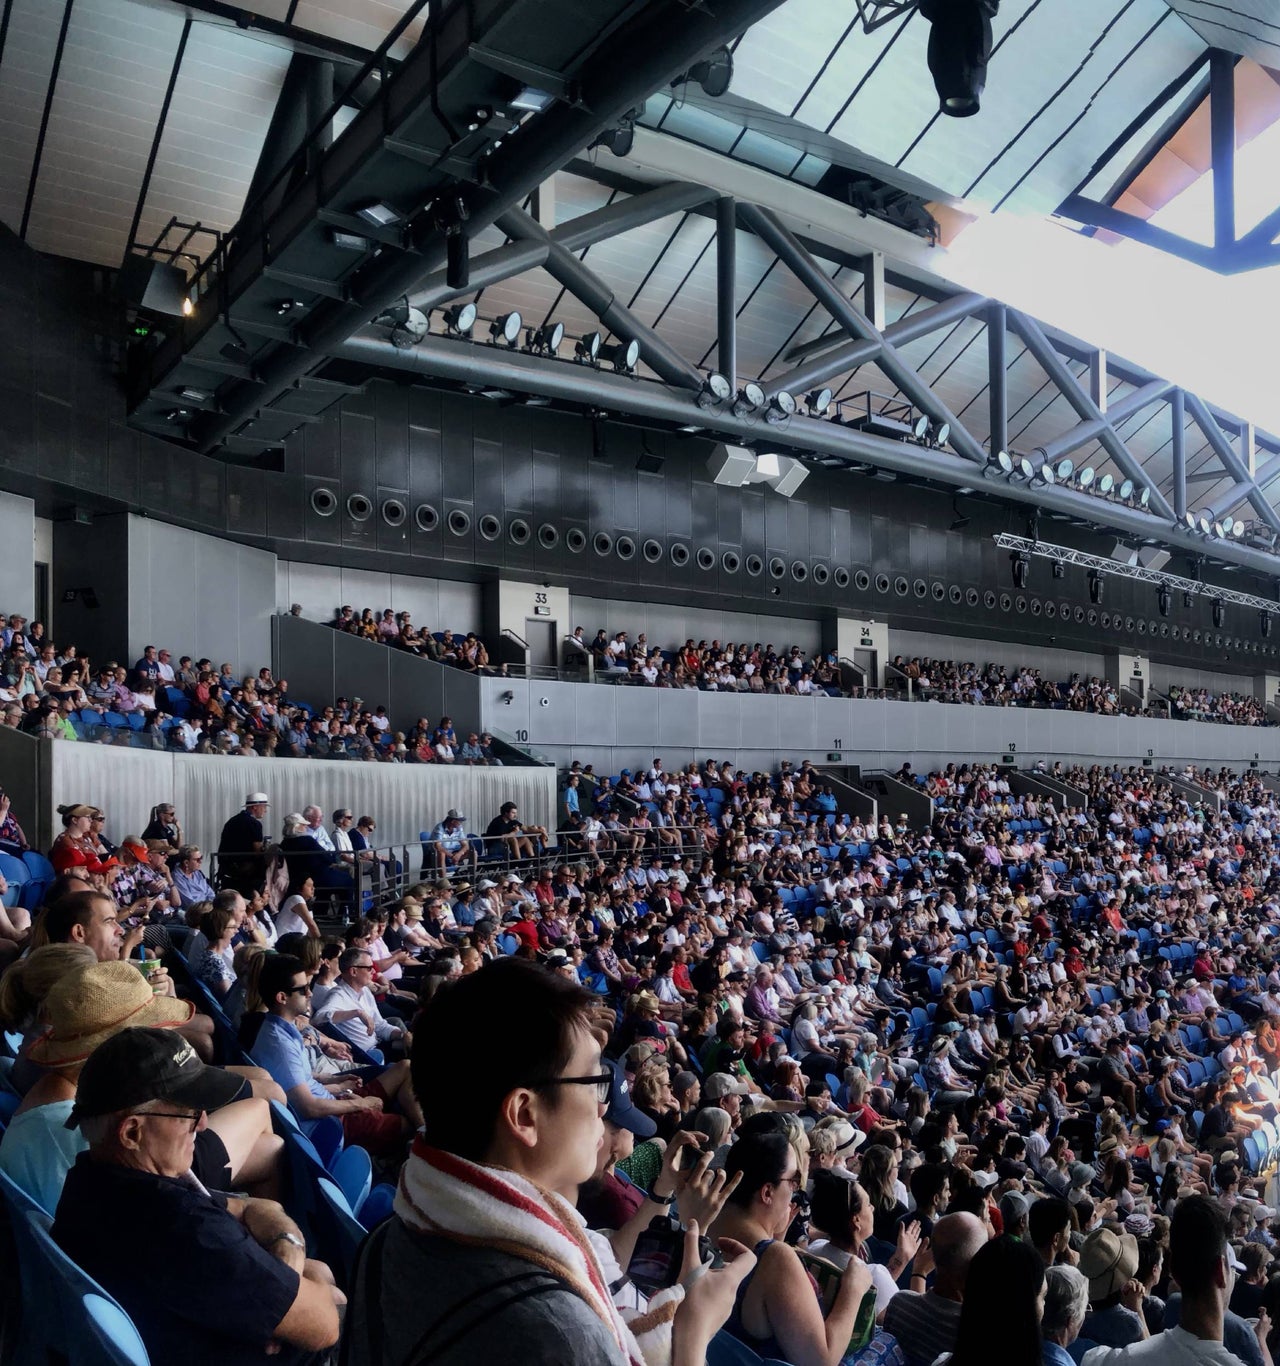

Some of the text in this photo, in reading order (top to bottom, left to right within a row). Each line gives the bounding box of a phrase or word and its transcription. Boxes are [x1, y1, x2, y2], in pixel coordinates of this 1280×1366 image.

[535, 592, 547, 604] 33
[861, 628, 870, 636] 34
[516, 730, 528, 741] 10
[834, 739, 842, 749] 11
[1008, 743, 1016, 751] 12
